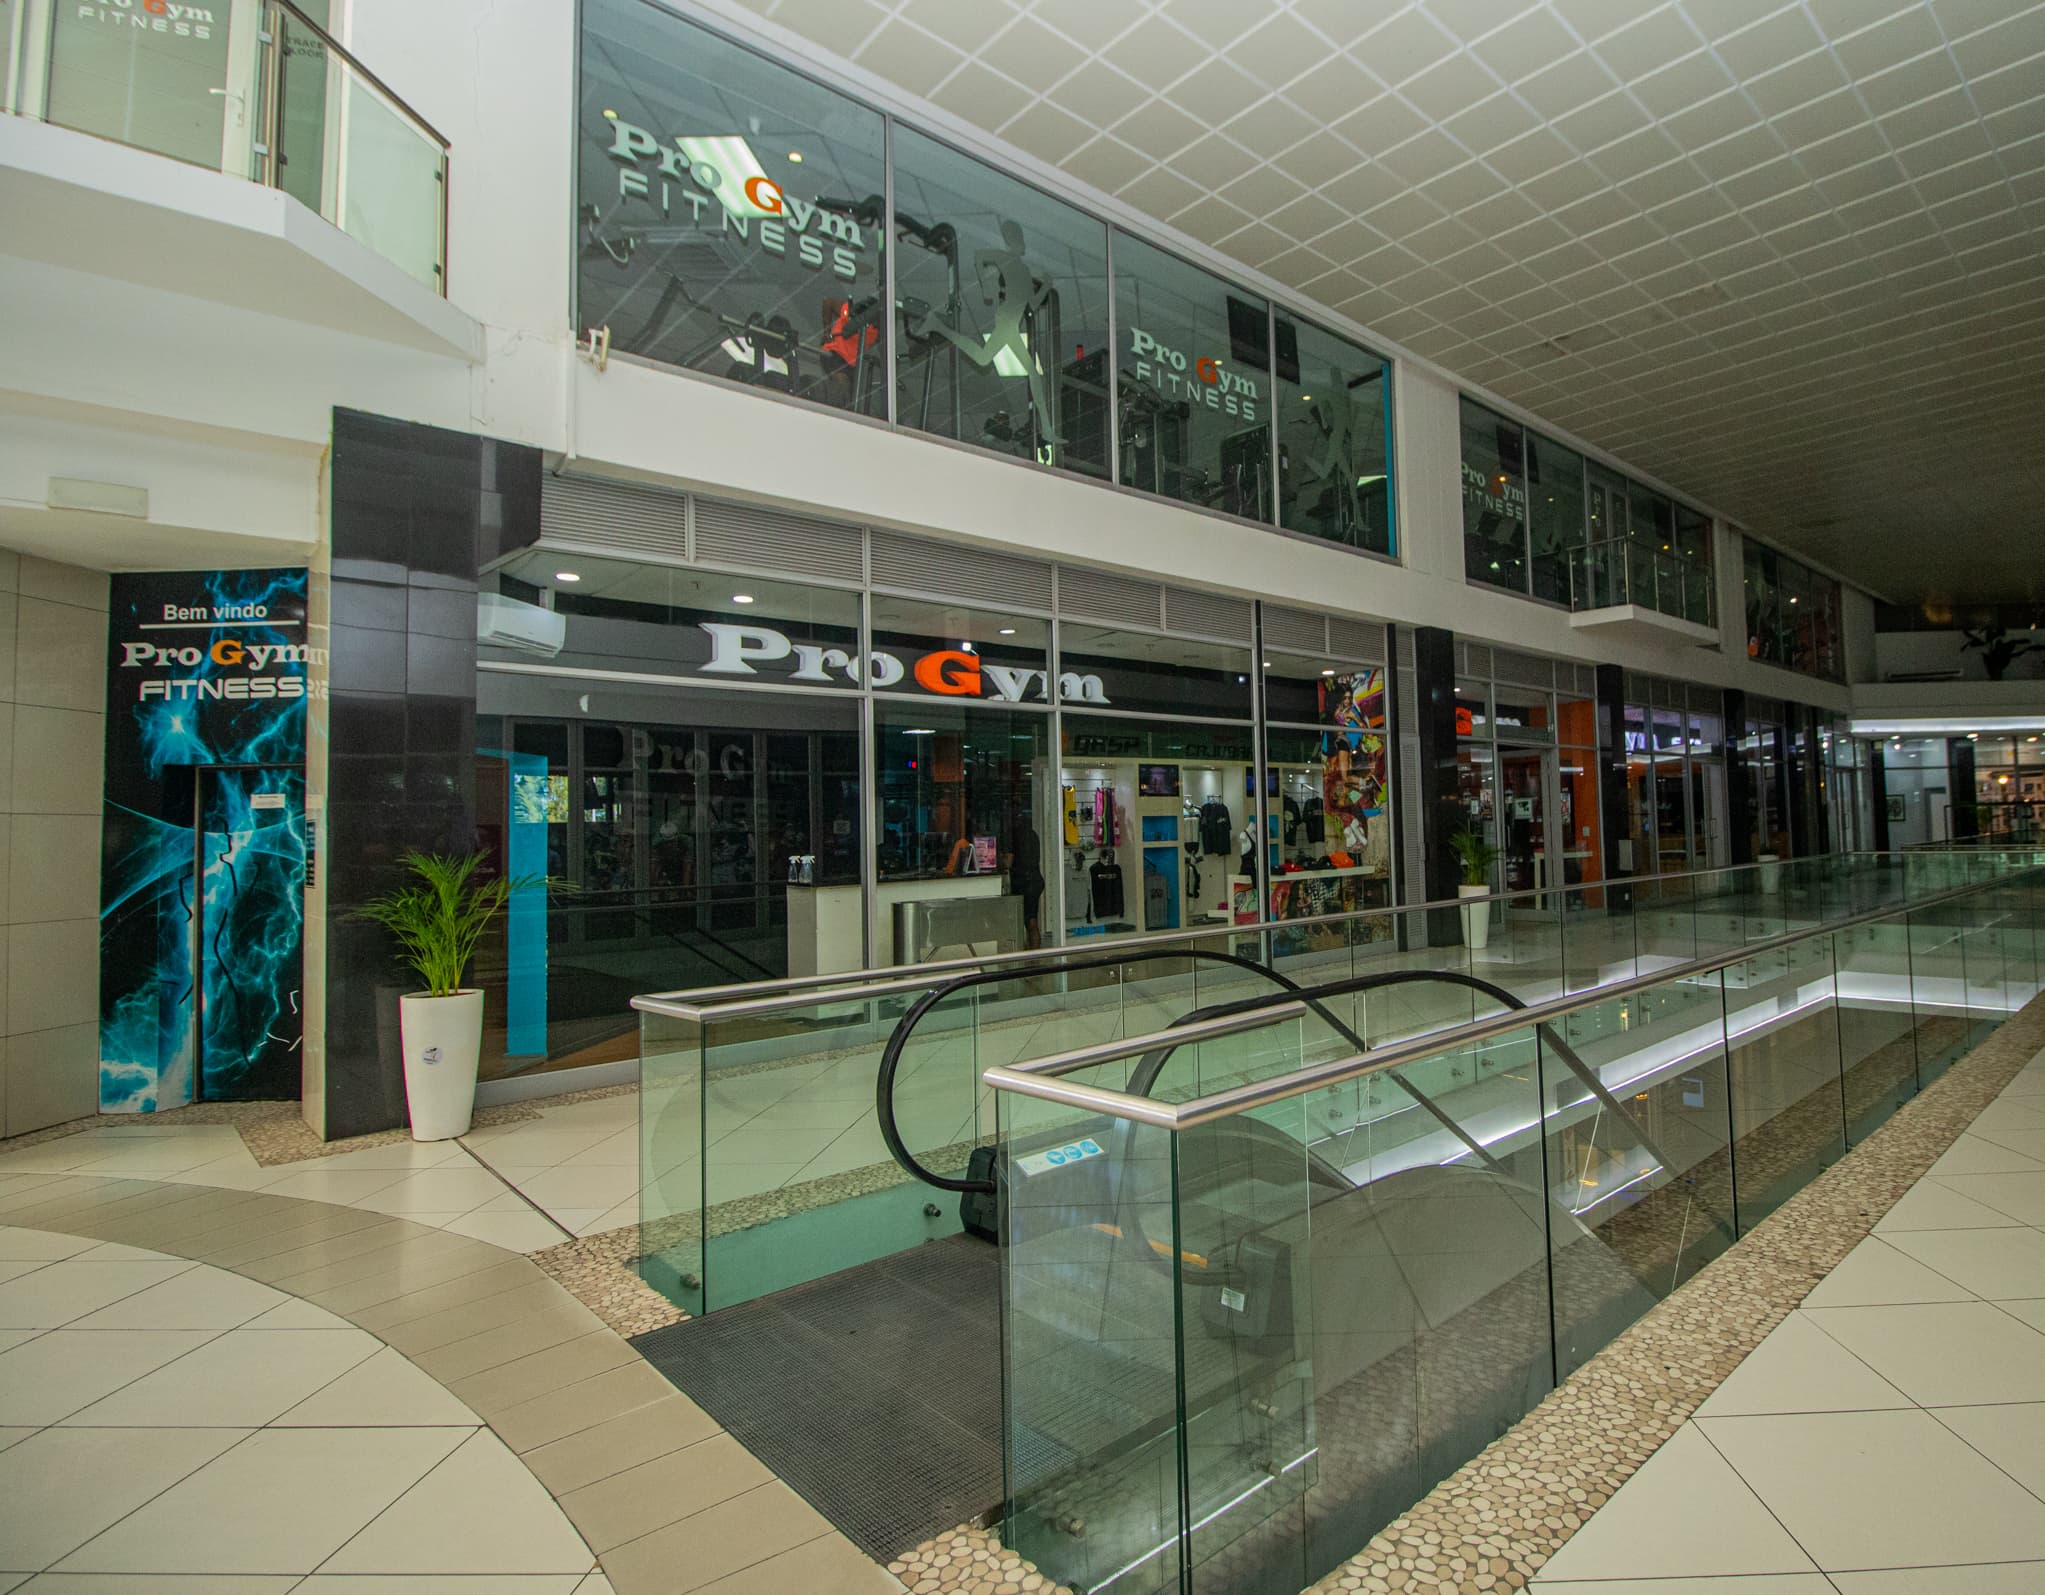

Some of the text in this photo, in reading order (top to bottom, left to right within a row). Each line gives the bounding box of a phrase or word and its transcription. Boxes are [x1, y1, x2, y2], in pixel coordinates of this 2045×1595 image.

[78, 6, 211, 39] FITNESS
[607, 118, 865, 248] Pro Gym
[619, 168, 857, 277] FITNESS
[1130, 327, 1259, 400] Pro Gym
[1136, 361, 1256, 421] FITNESS
[163, 602, 268, 621] Bem vindo
[120, 639, 309, 671] Pro Gym
[698, 622, 1112, 704] Pro Gym
[139, 676, 305, 701] FITNESS
